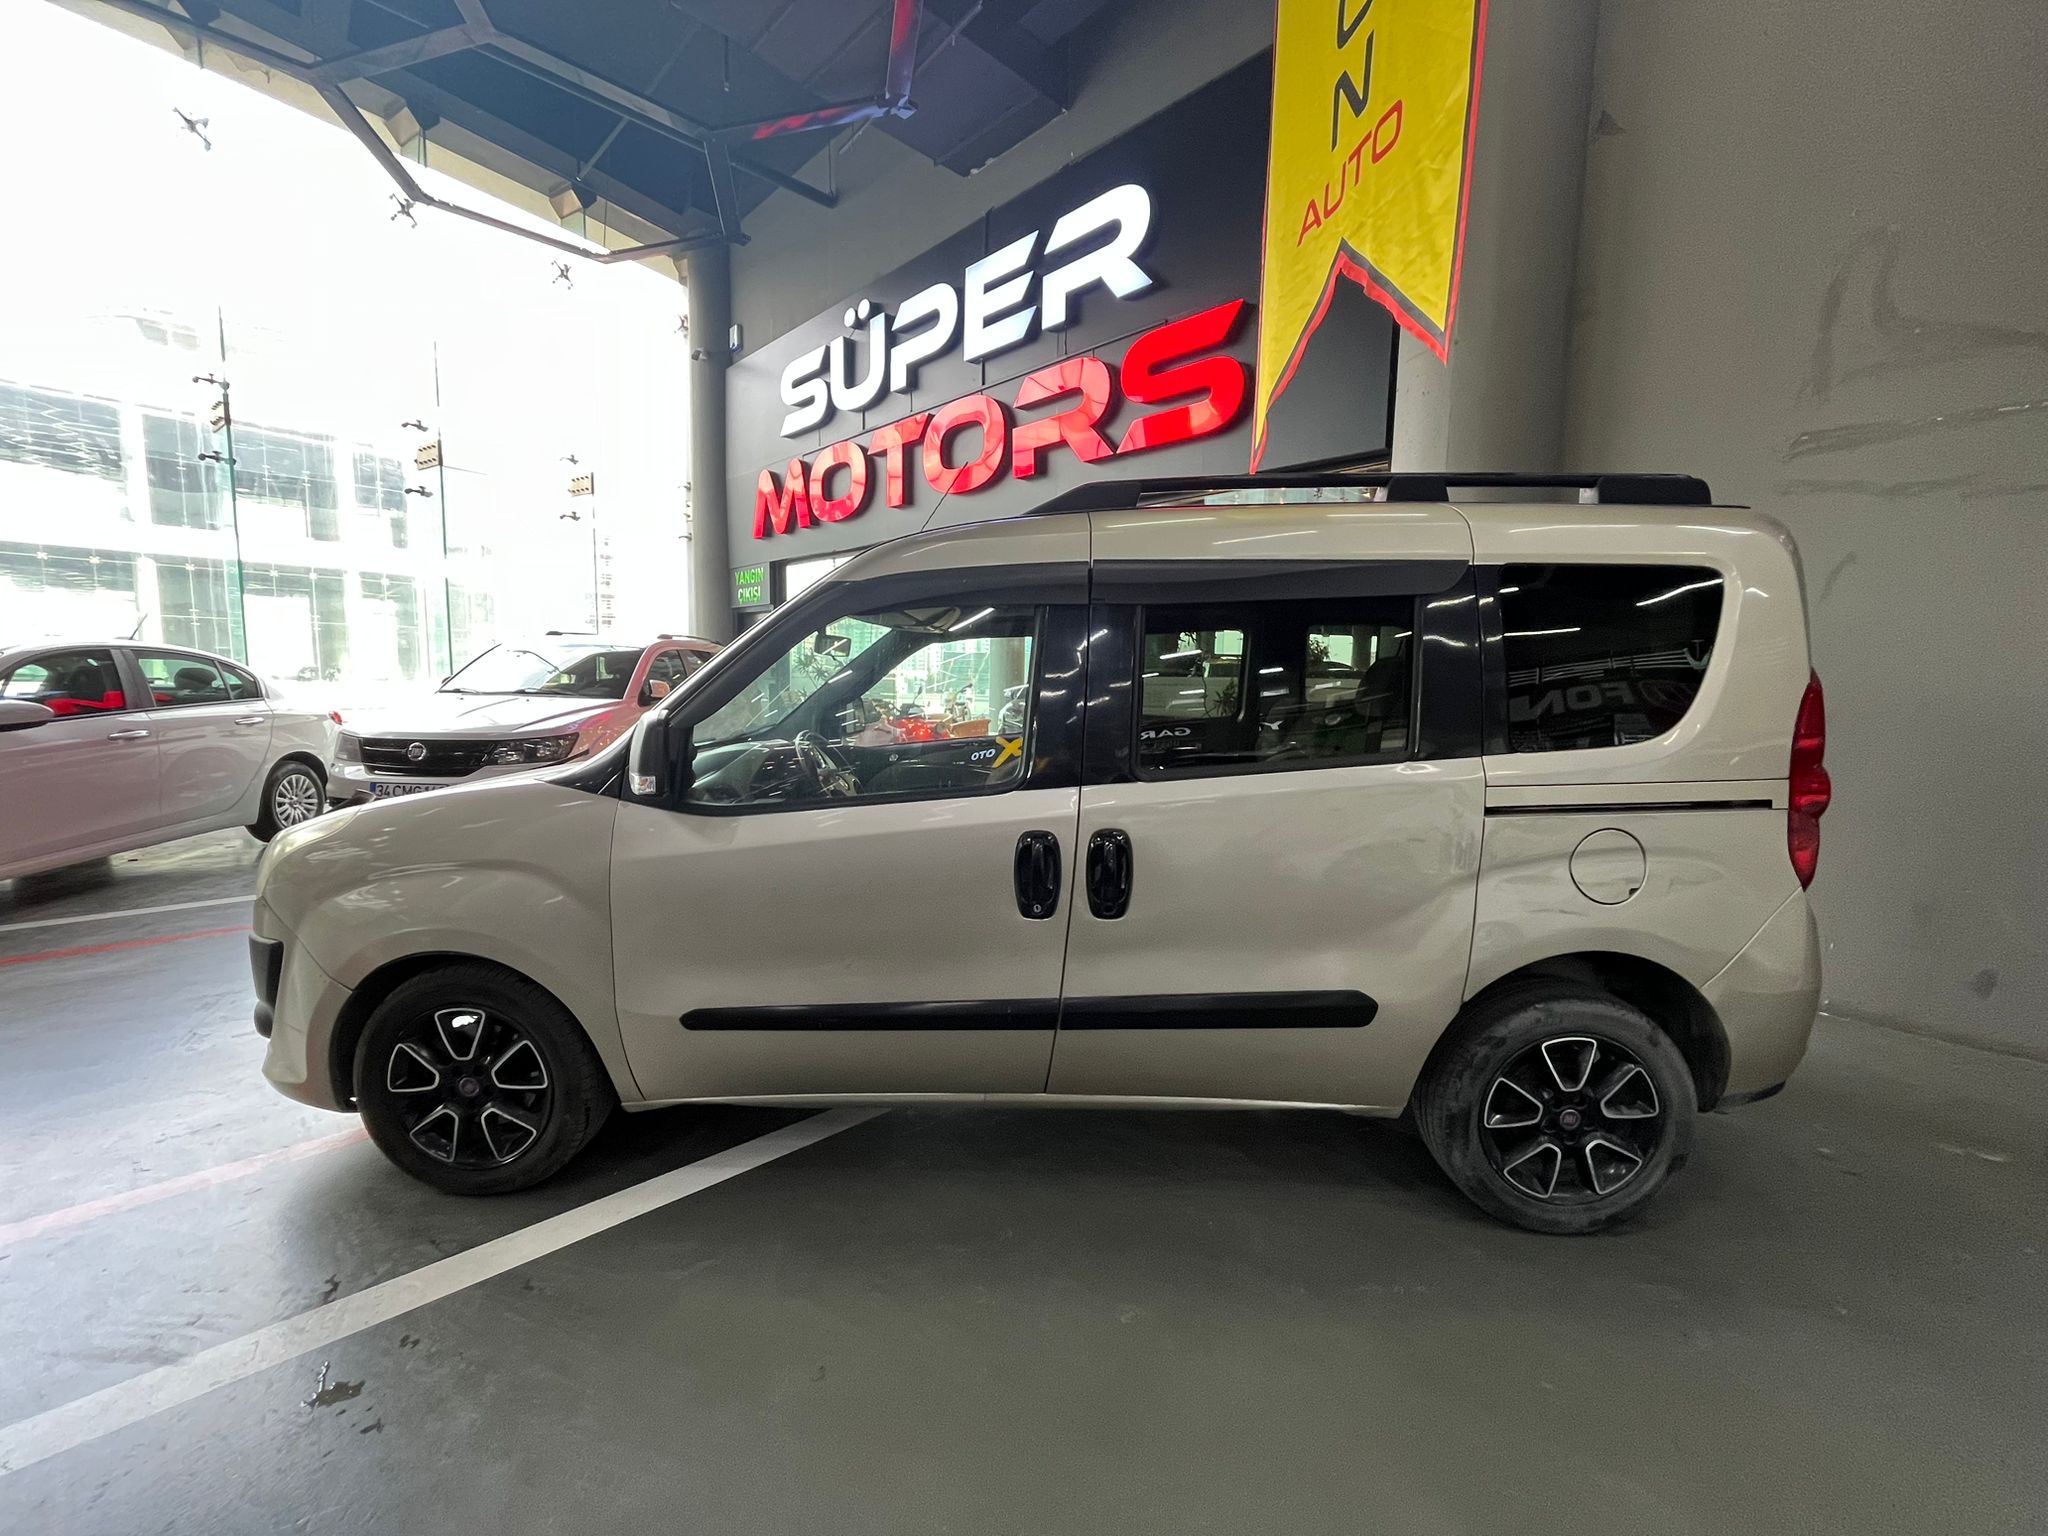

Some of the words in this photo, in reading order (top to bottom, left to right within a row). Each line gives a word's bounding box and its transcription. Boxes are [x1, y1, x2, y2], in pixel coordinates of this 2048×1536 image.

[1296, 98, 1404, 249] AUTO
[780, 183, 1154, 438] SÜPER
[753, 299, 1246, 539] MOTORS
[735, 567, 764, 586] YANGIN
[376, 785, 391, 797] 34
